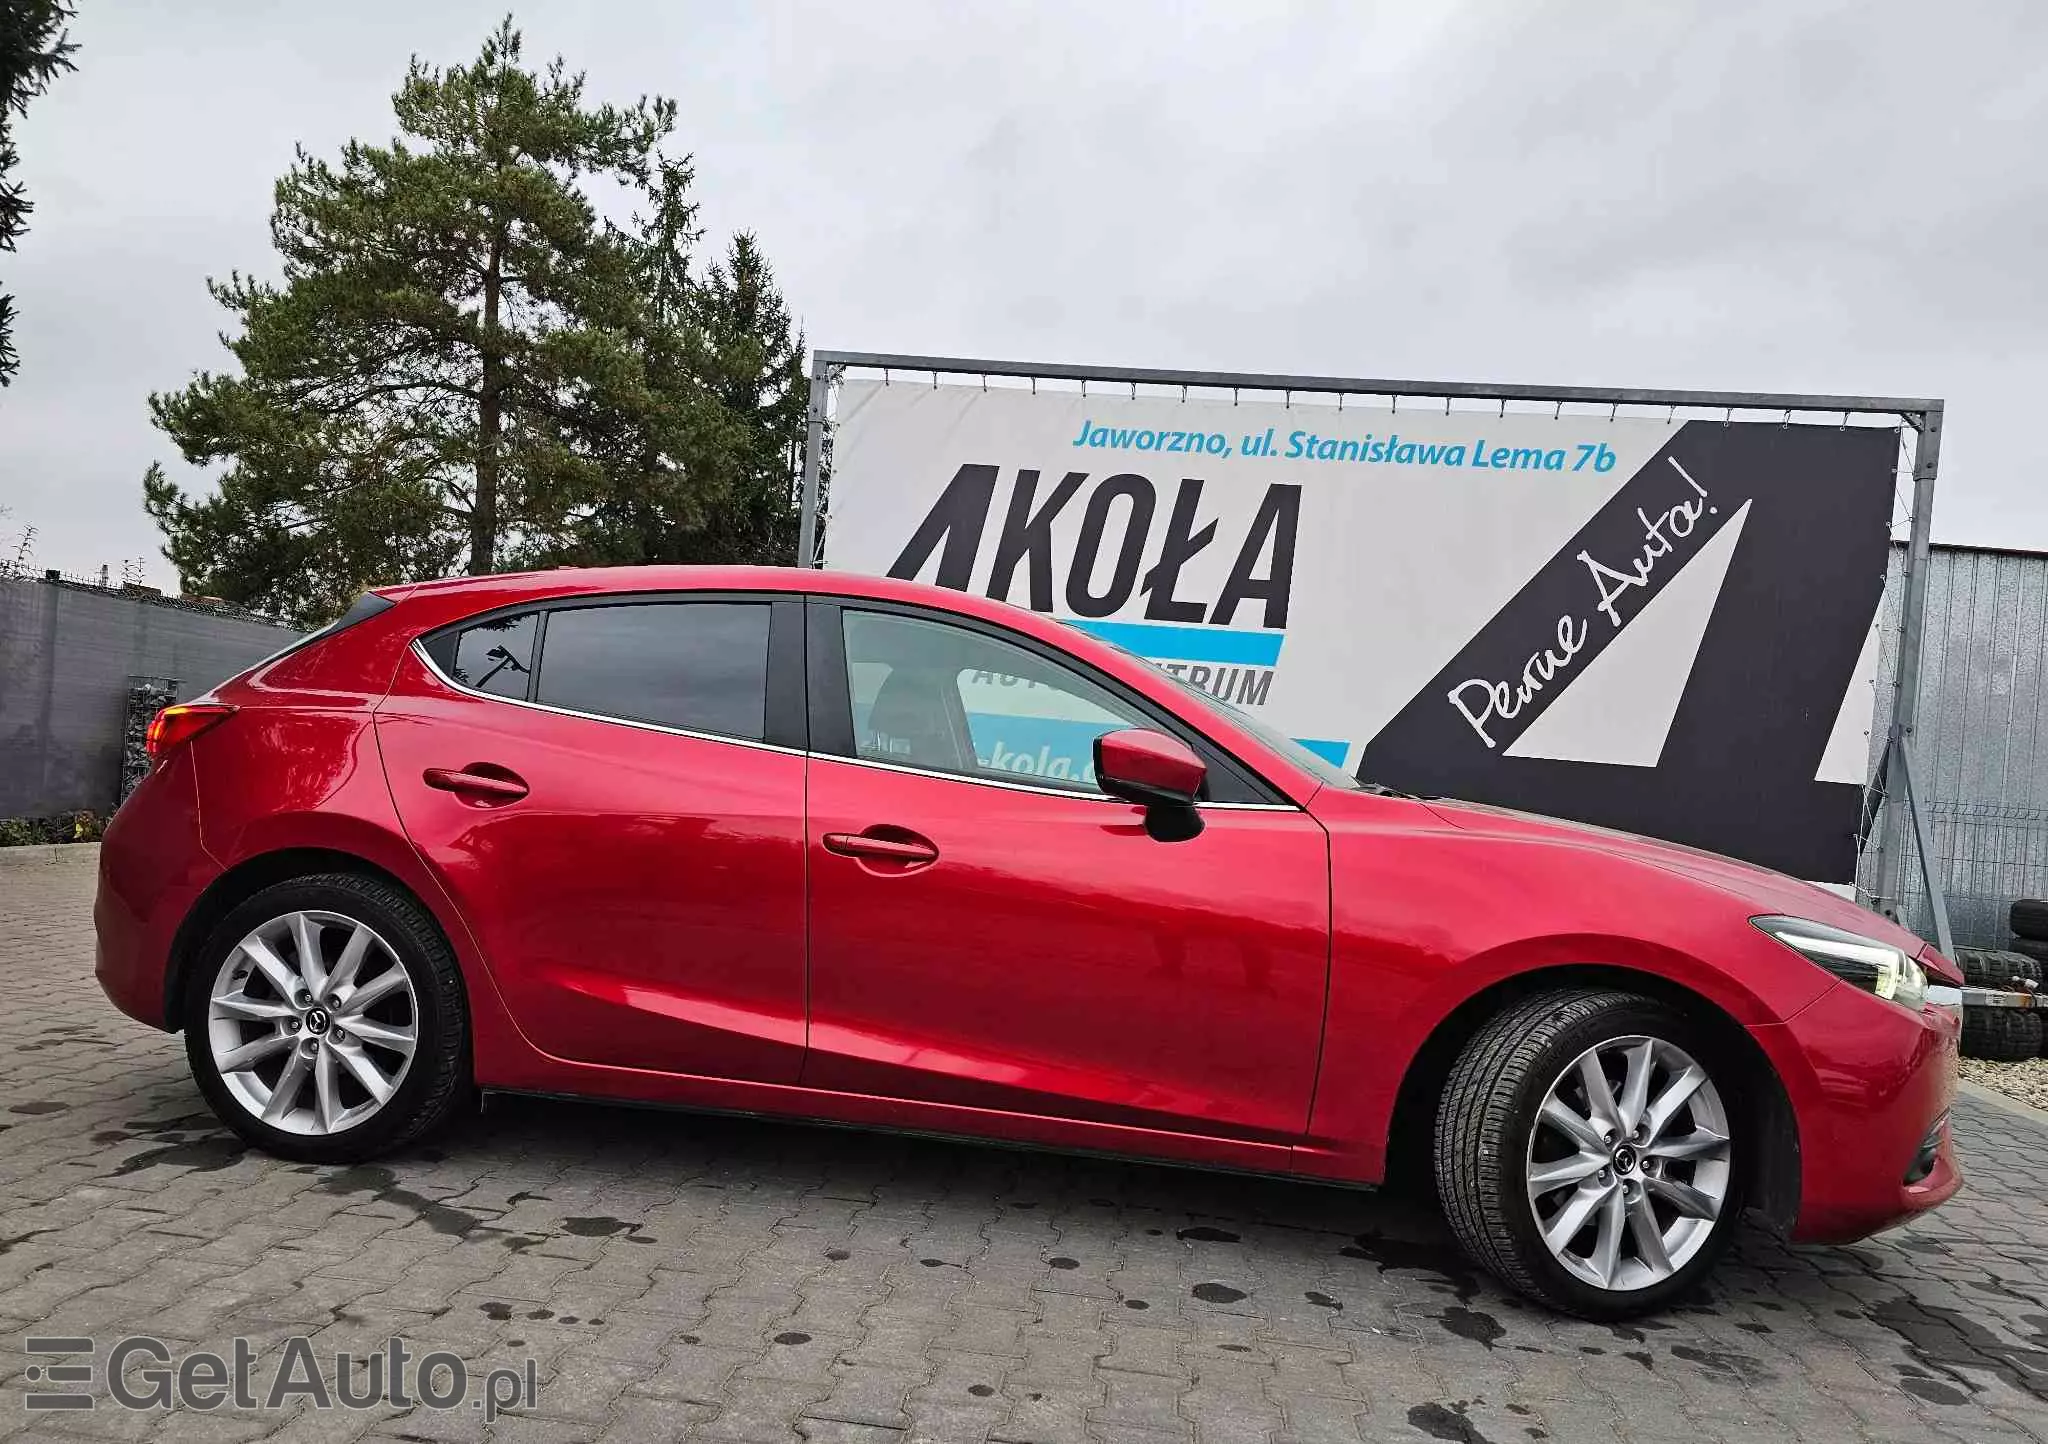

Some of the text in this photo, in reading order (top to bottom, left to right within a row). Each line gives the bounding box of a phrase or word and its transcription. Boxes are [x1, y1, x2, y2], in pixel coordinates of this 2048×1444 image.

[1072, 420, 1617, 473] Jaworzno, ul. Stanisława Lema 7b
[886, 463, 1303, 629] AKOŁA
[1576, 455, 1718, 627] Auta!
[1156, 663, 1274, 706] TRUM
